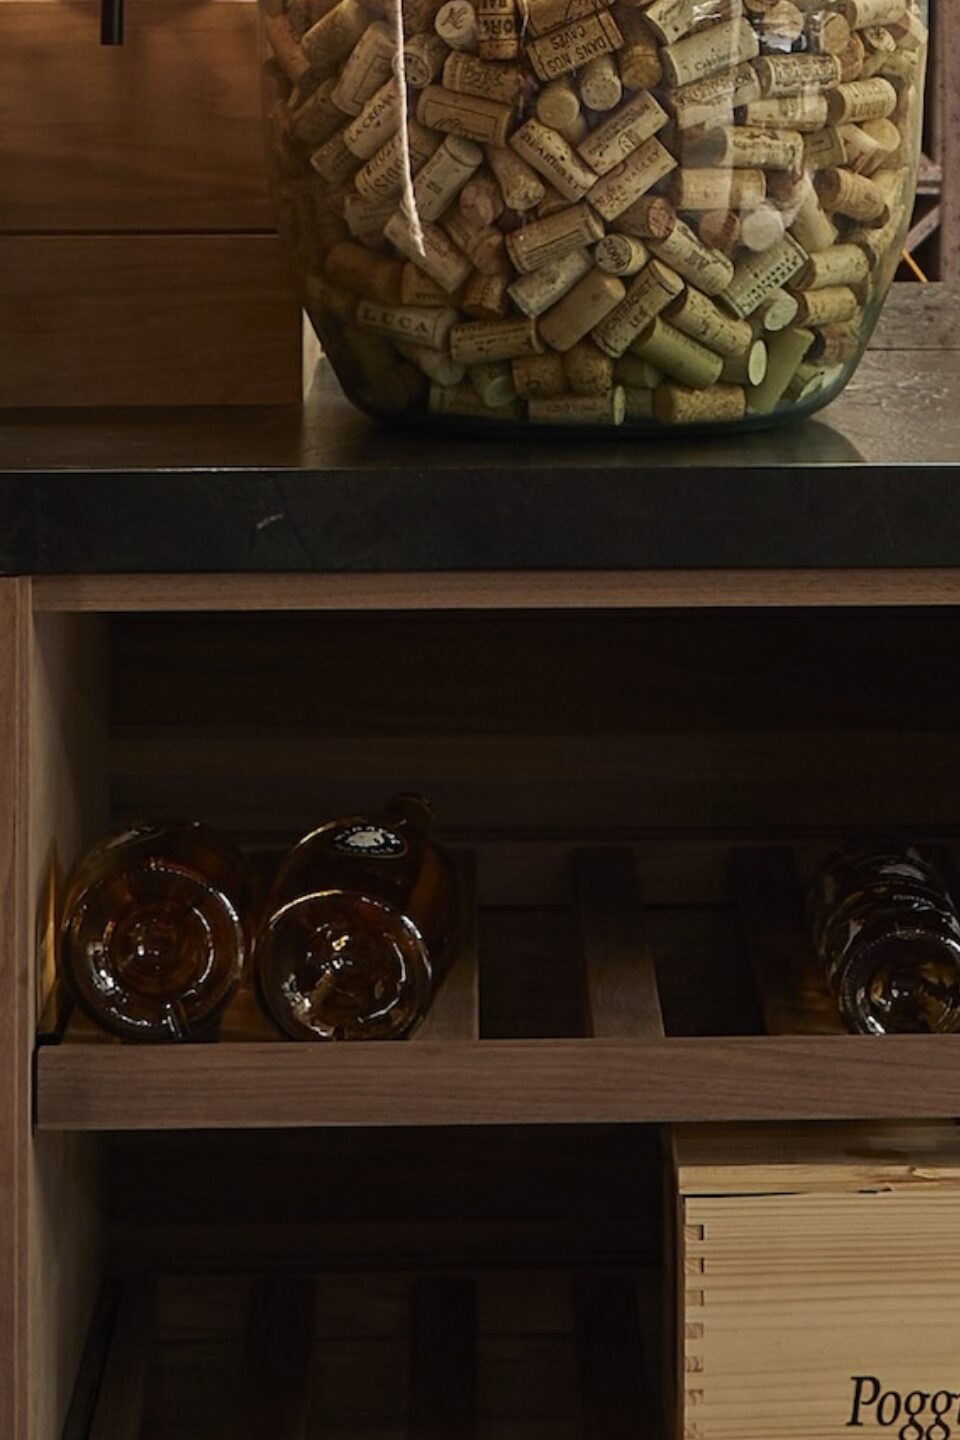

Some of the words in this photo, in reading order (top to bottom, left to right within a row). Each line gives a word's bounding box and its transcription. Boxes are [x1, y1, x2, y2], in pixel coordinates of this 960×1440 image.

[550, 24, 587, 52] CAVES
[575, 36, 608, 59] DANS
[362, 306, 430, 334] LUCA
